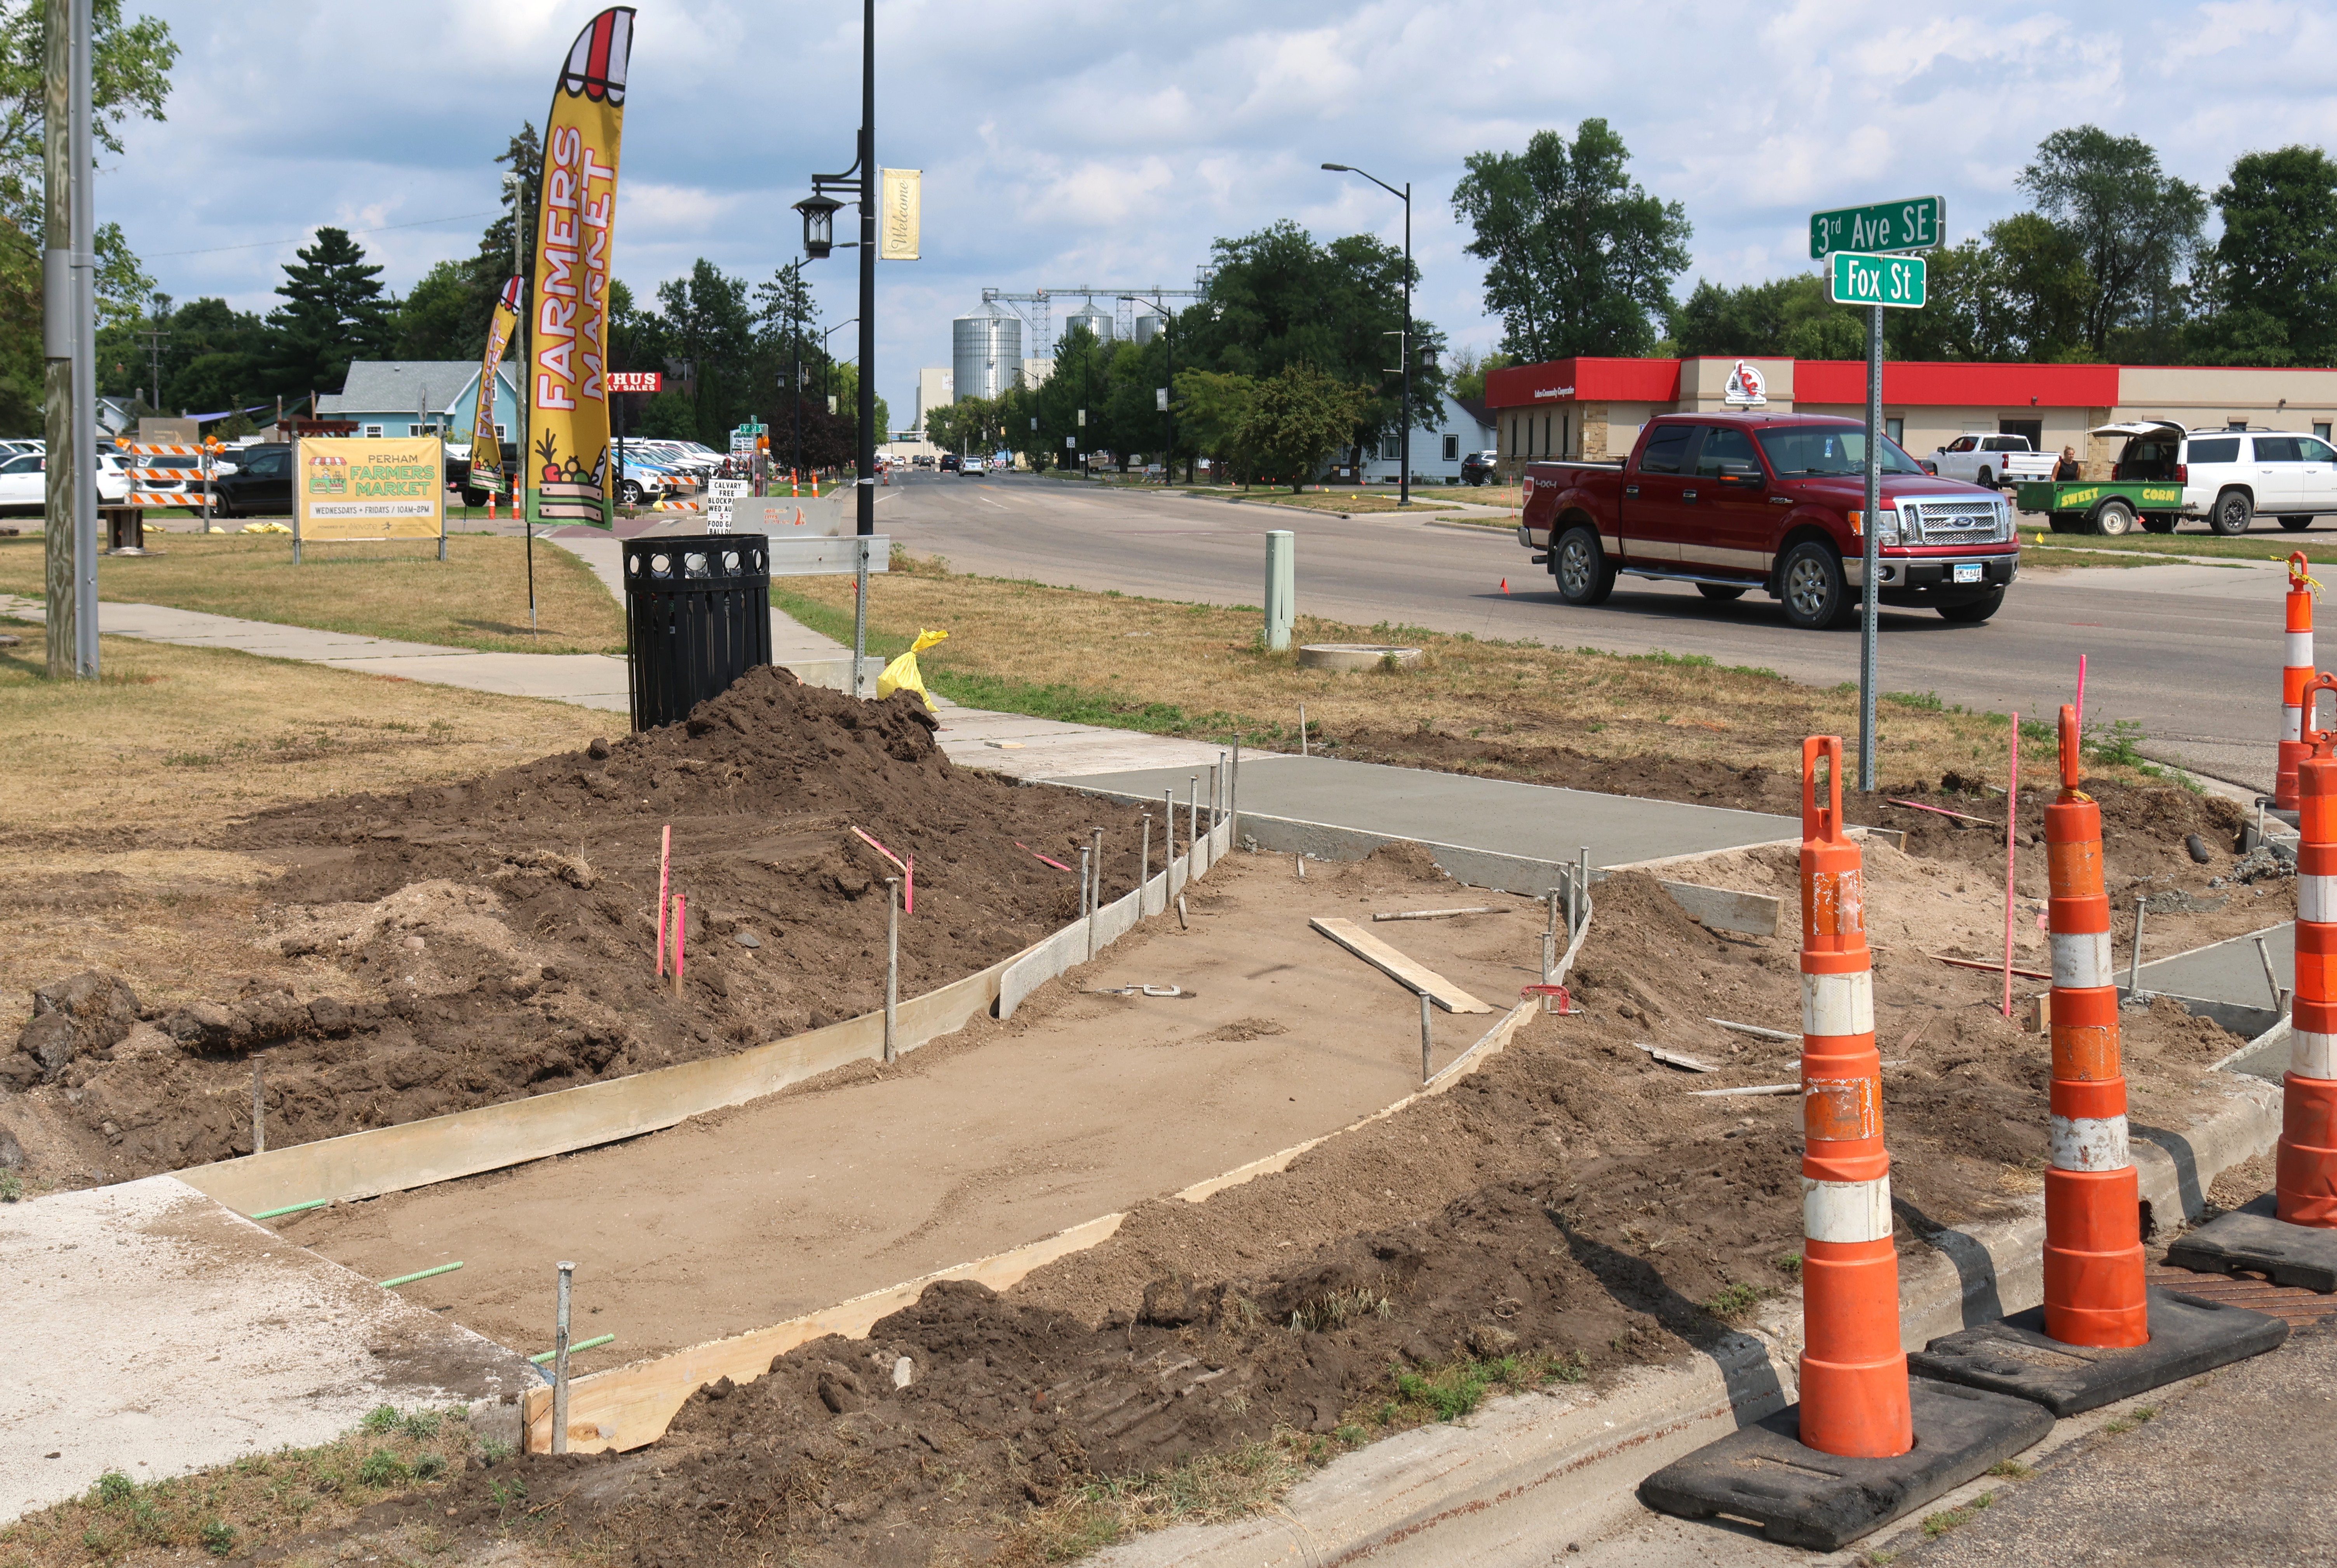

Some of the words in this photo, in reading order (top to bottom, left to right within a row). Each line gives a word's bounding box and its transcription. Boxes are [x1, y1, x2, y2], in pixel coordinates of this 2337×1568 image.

[891, 179, 909, 249] Welcome
[1818, 216, 1841, 254] 3rd
[1851, 213, 1890, 249] Ave
[1902, 204, 1929, 243] SE
[537, 125, 581, 411] FARMERS
[582, 147, 614, 404] MARKET
[1848, 260, 1880, 298] Fox
[1890, 263, 1911, 299] St
[350, 465, 435, 480] FARMERS
[369, 455, 418, 463] PERHAM
[355, 482, 431, 496] MARKET
[2061, 487, 2098, 507] SWEET
[2142, 488, 2175, 501] CORN
[315, 506, 357, 515] WEDNESDAYS
